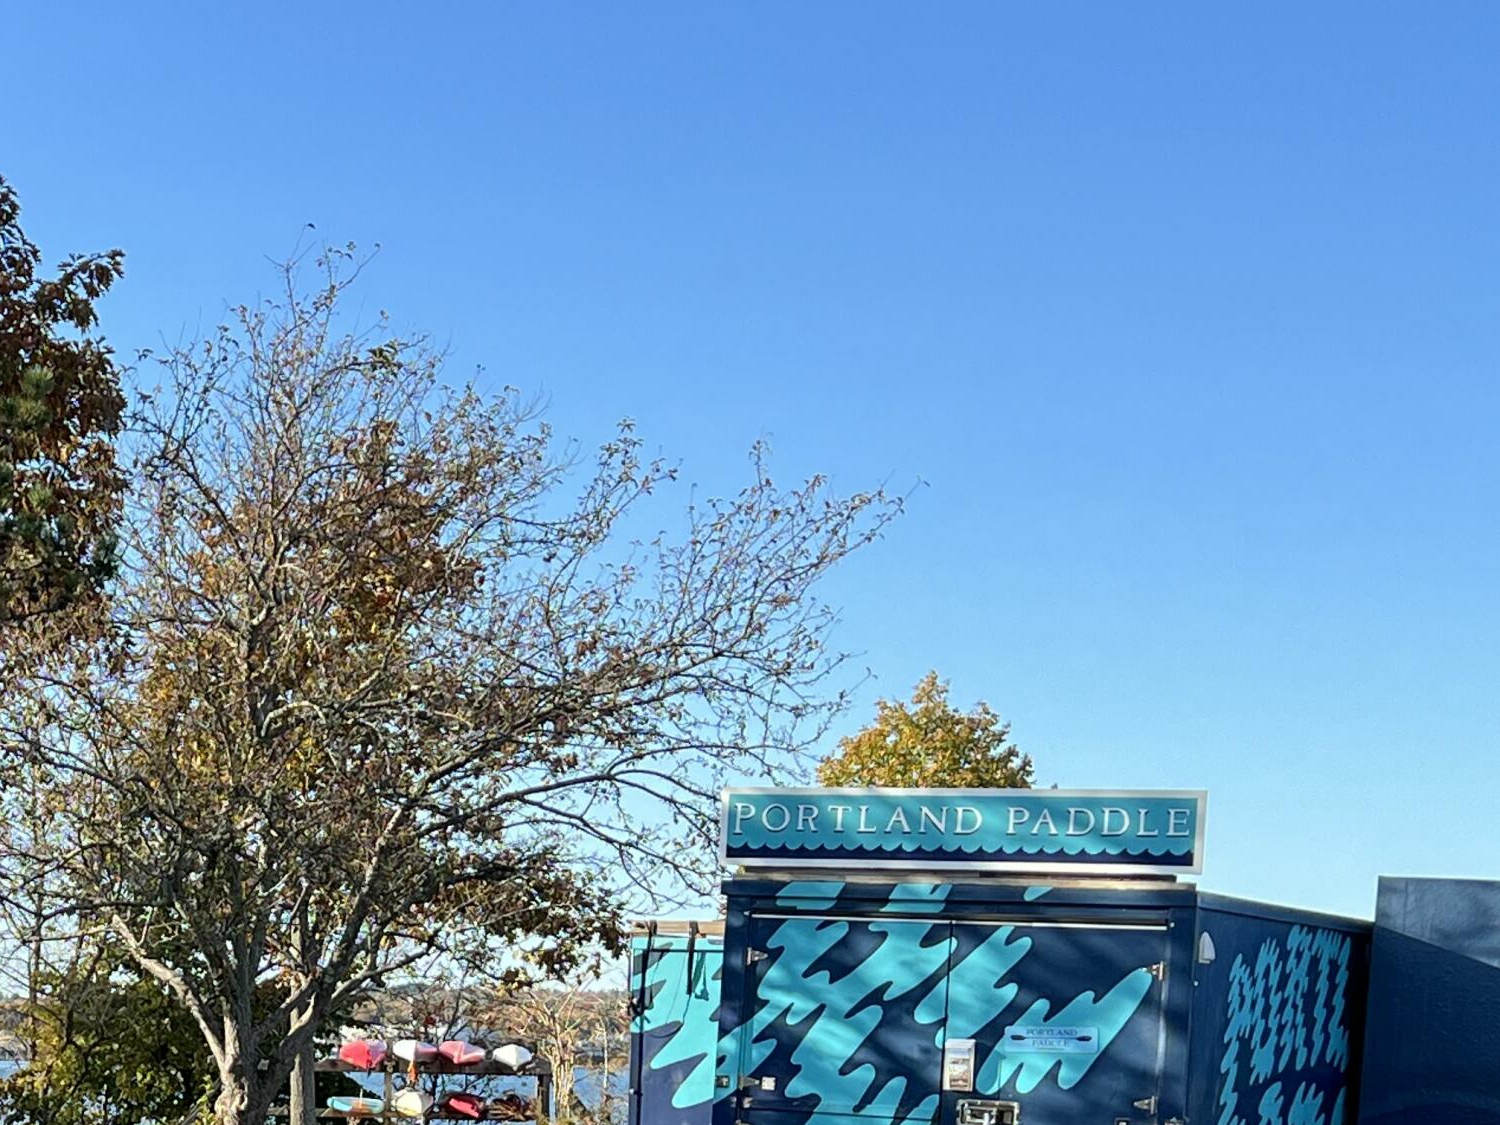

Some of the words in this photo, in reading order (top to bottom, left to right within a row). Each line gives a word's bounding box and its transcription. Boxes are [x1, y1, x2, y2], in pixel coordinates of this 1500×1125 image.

[732, 802, 983, 835] PORTLAND
[1005, 806, 1191, 837] PADDLE
[1026, 1028, 1078, 1036] PORTLAND
